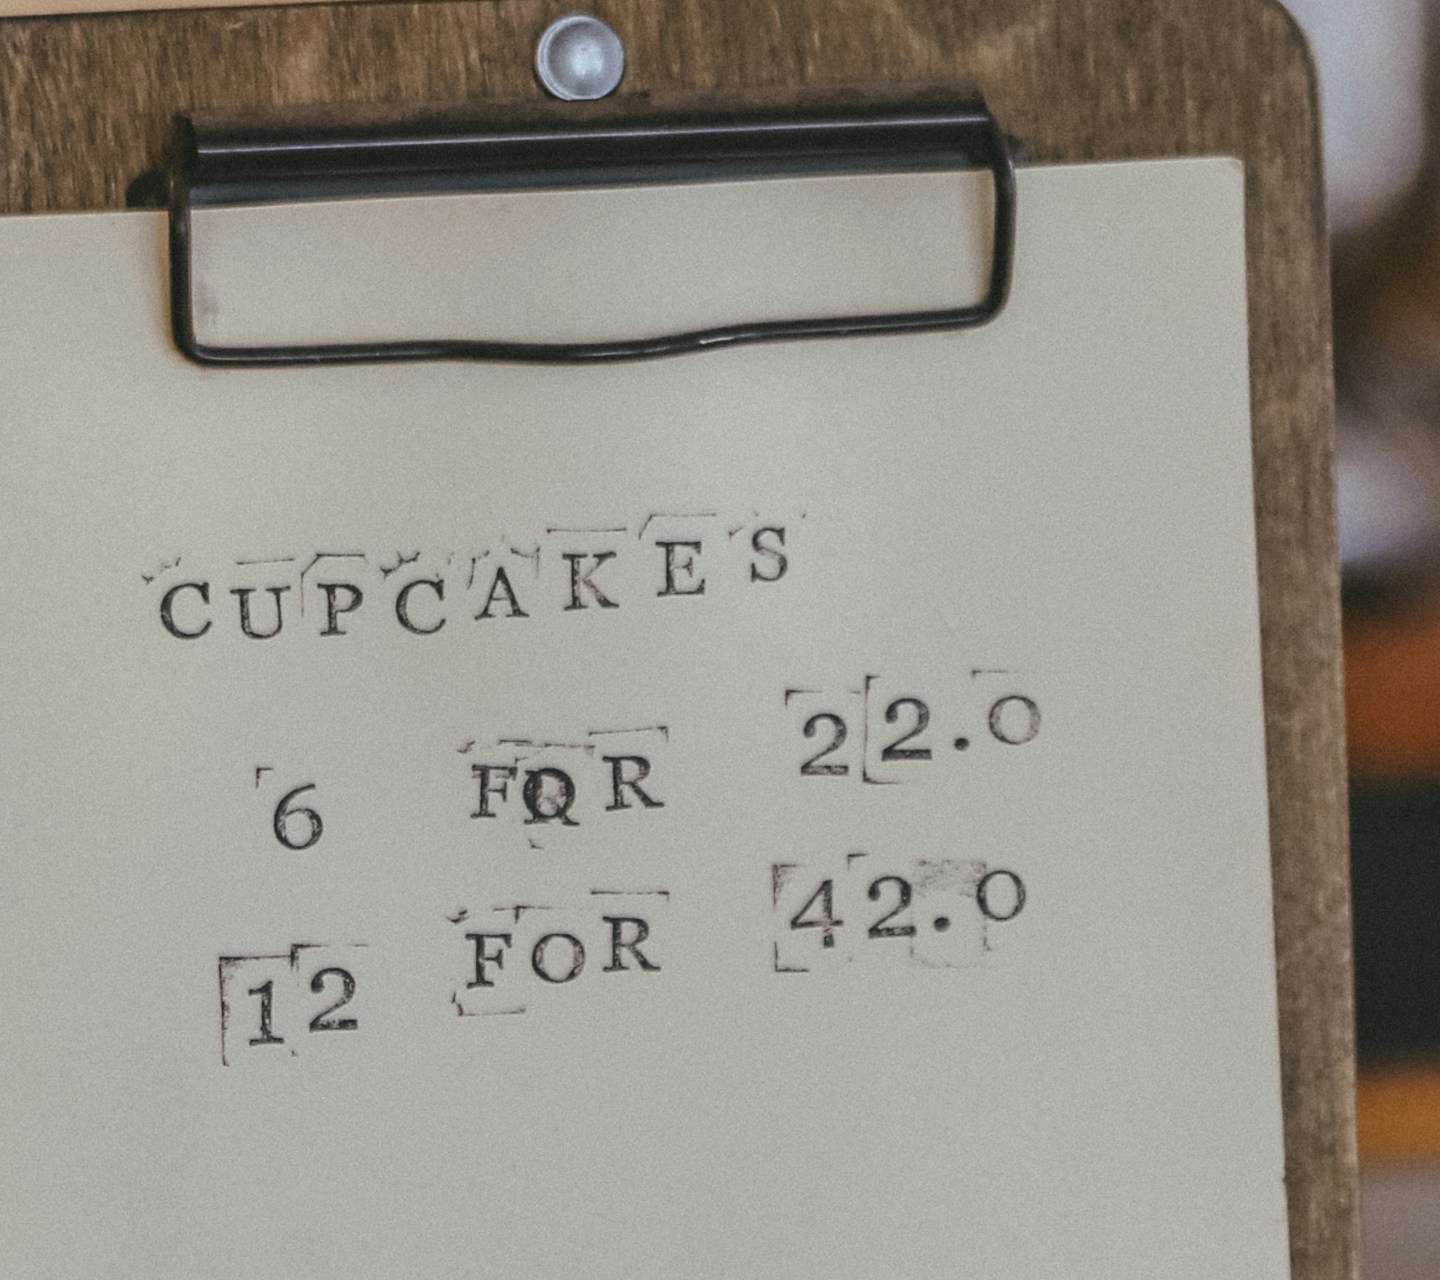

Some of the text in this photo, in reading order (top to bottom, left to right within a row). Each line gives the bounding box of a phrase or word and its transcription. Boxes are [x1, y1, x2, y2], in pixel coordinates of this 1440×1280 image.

[158, 524, 792, 641] CUPCAKES
[272, 782, 324, 850] 6
[800, 693, 1042, 777] 22.0
[248, 868, 1028, 1046] 12 FOR 42.0
